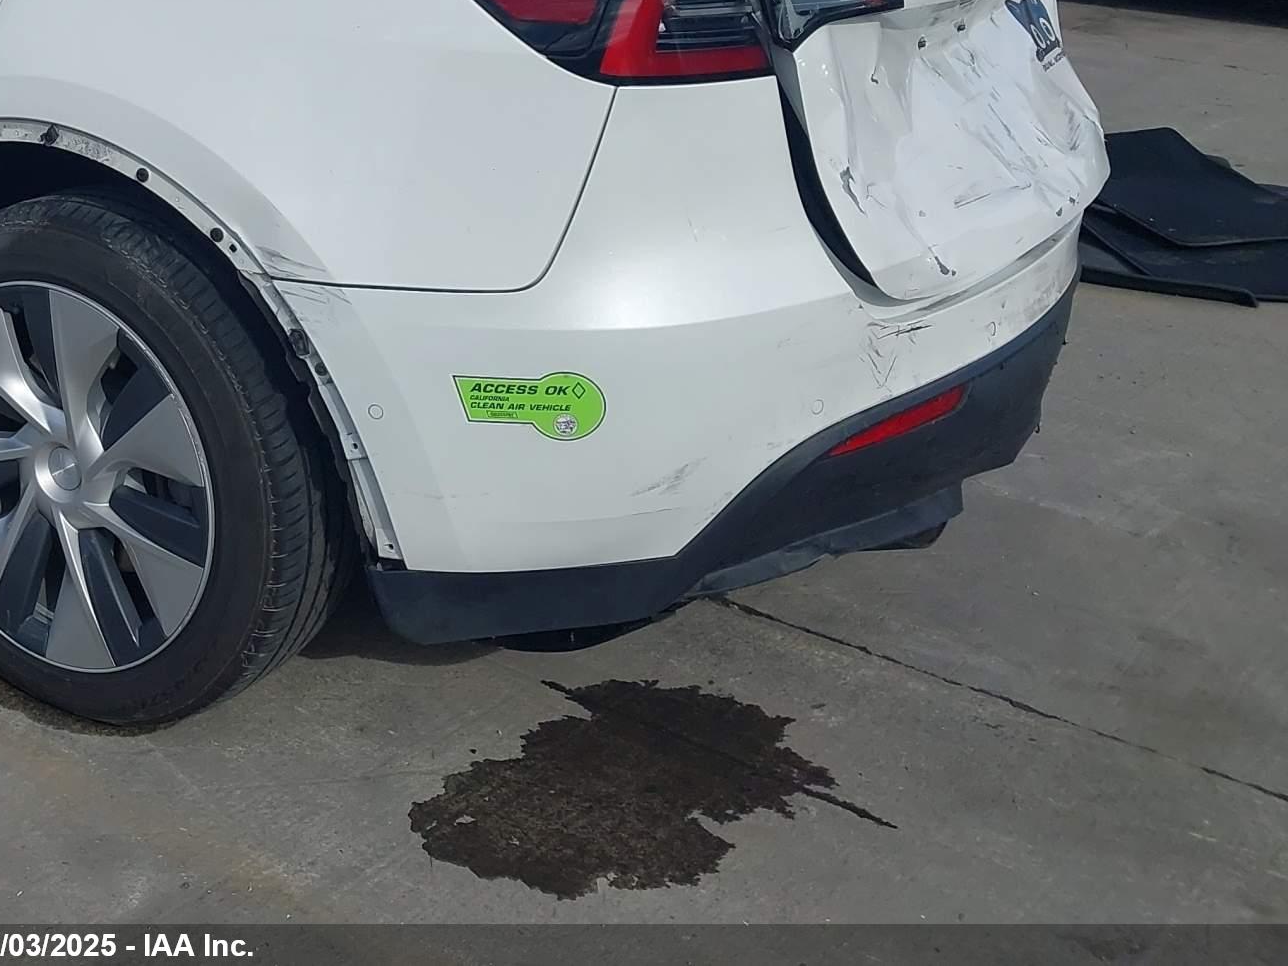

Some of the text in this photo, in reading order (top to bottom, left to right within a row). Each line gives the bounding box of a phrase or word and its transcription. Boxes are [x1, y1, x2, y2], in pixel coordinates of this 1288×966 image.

[470, 383, 571, 396] ACCESS OK
[470, 401, 572, 412] CLEAN AIR VEHICLE
